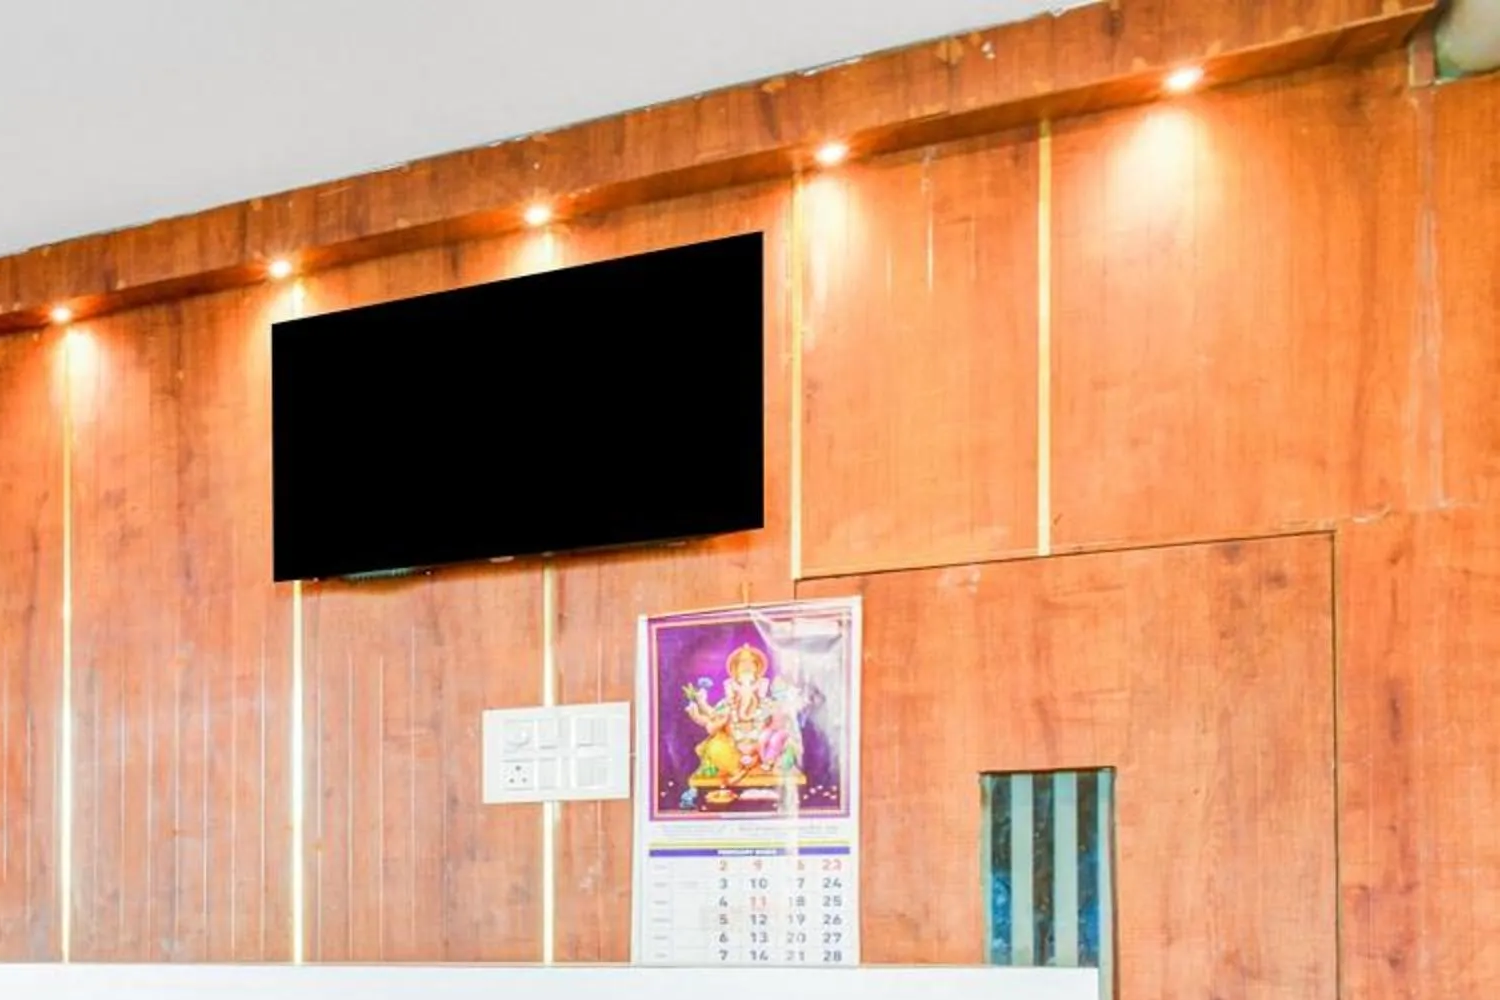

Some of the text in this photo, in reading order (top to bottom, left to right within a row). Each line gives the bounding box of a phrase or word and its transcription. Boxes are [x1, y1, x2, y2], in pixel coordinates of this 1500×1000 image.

[822, 858, 842, 871] 23
[750, 877, 768, 889] 10
[822, 877, 842, 889] 24
[750, 895, 767, 907] 11
[822, 895, 842, 907] 25
[750, 913, 768, 925] 12
[822, 913, 842, 925] 26
[750, 931, 768, 944] 13
[822, 931, 842, 944] 27
[750, 949, 768, 961] 14
[822, 949, 842, 961] 28
